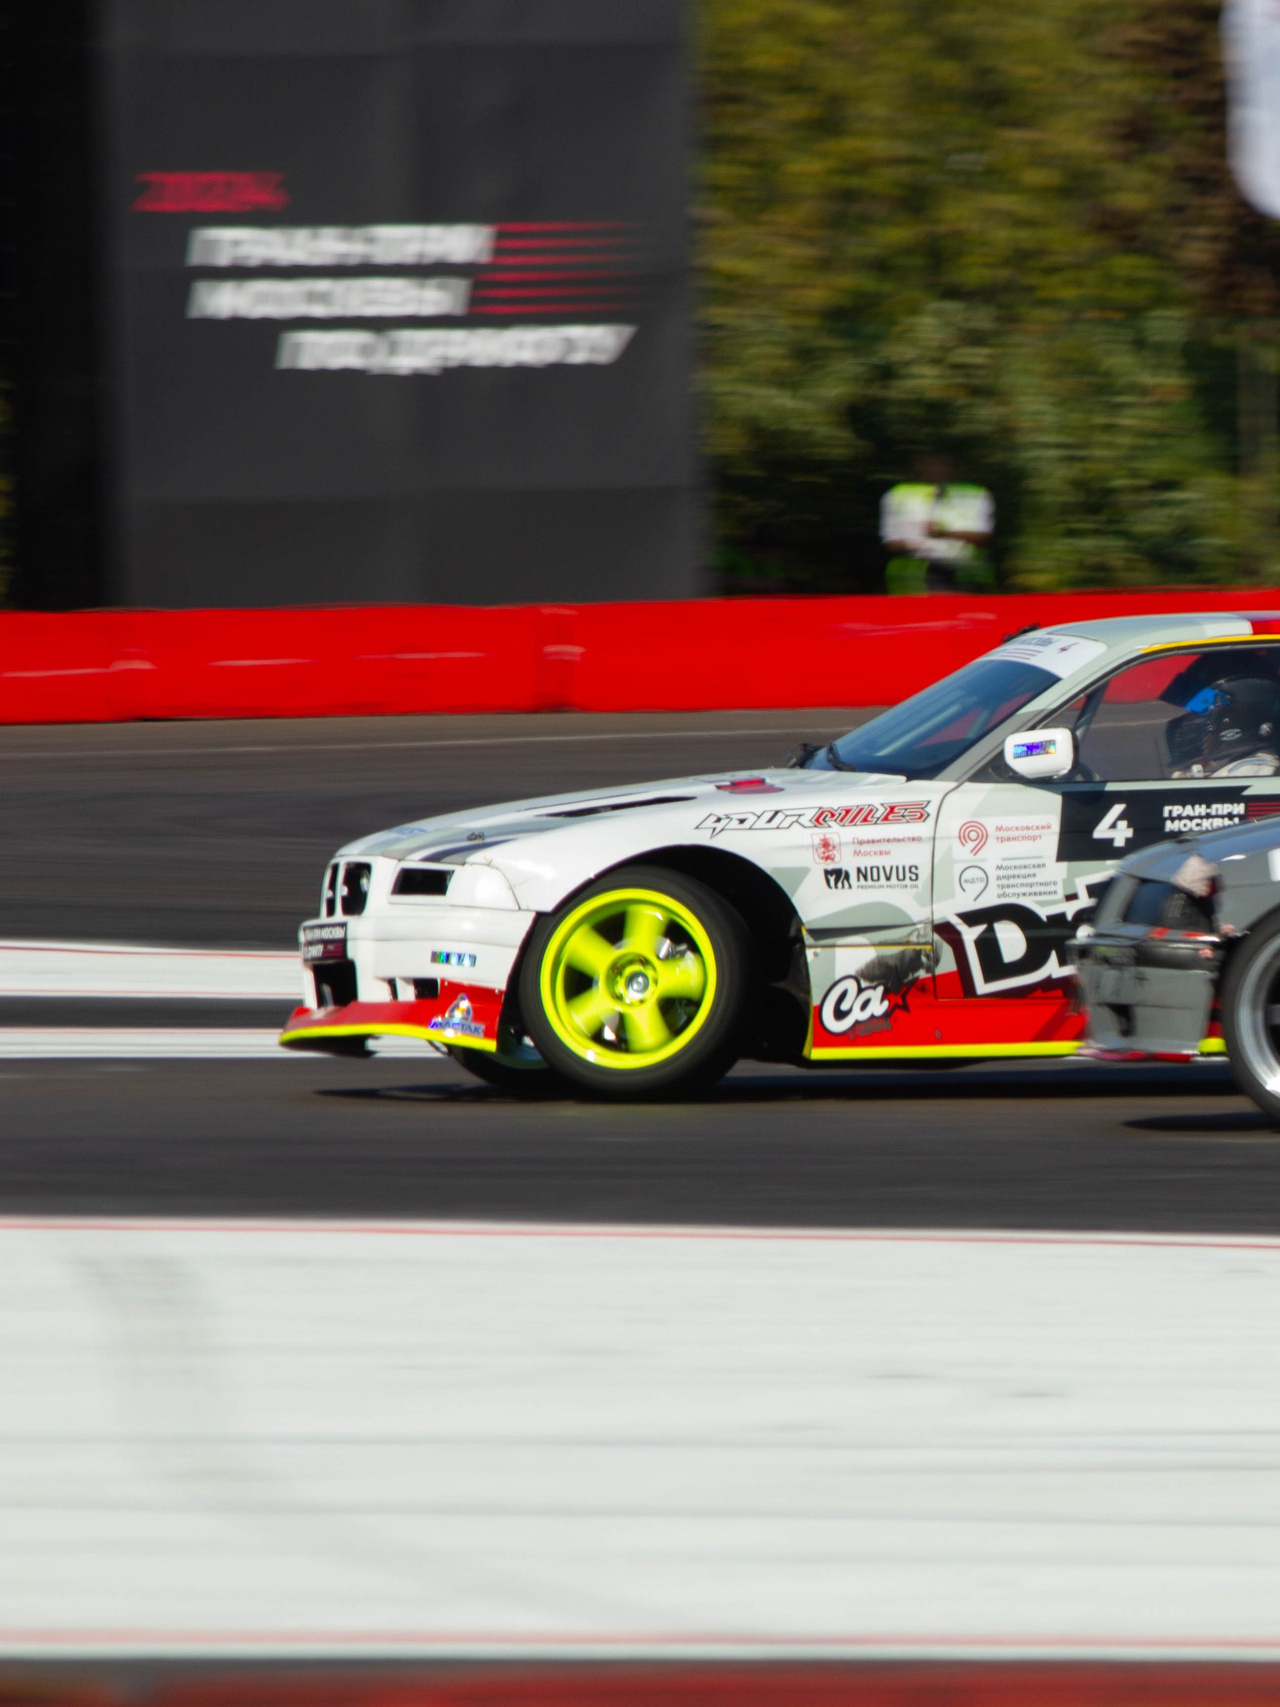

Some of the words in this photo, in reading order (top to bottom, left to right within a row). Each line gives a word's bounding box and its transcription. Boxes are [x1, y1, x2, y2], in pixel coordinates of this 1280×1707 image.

[1162, 802, 1245, 818] ГРАН-ПРИ
[995, 822, 1052, 832] Московский
[1092, 803, 1134, 847] 4
[852, 836, 923, 846] Правительство
[995, 834, 1043, 844] транспорт
[853, 849, 891, 857] Москвы
[996, 863, 1046, 871] Московская
[856, 865, 919, 882] NOVUS
[996, 872, 1037, 881] дирекция
[996, 880, 1058, 890] транспортного
[997, 889, 1058, 899] обслуживания
